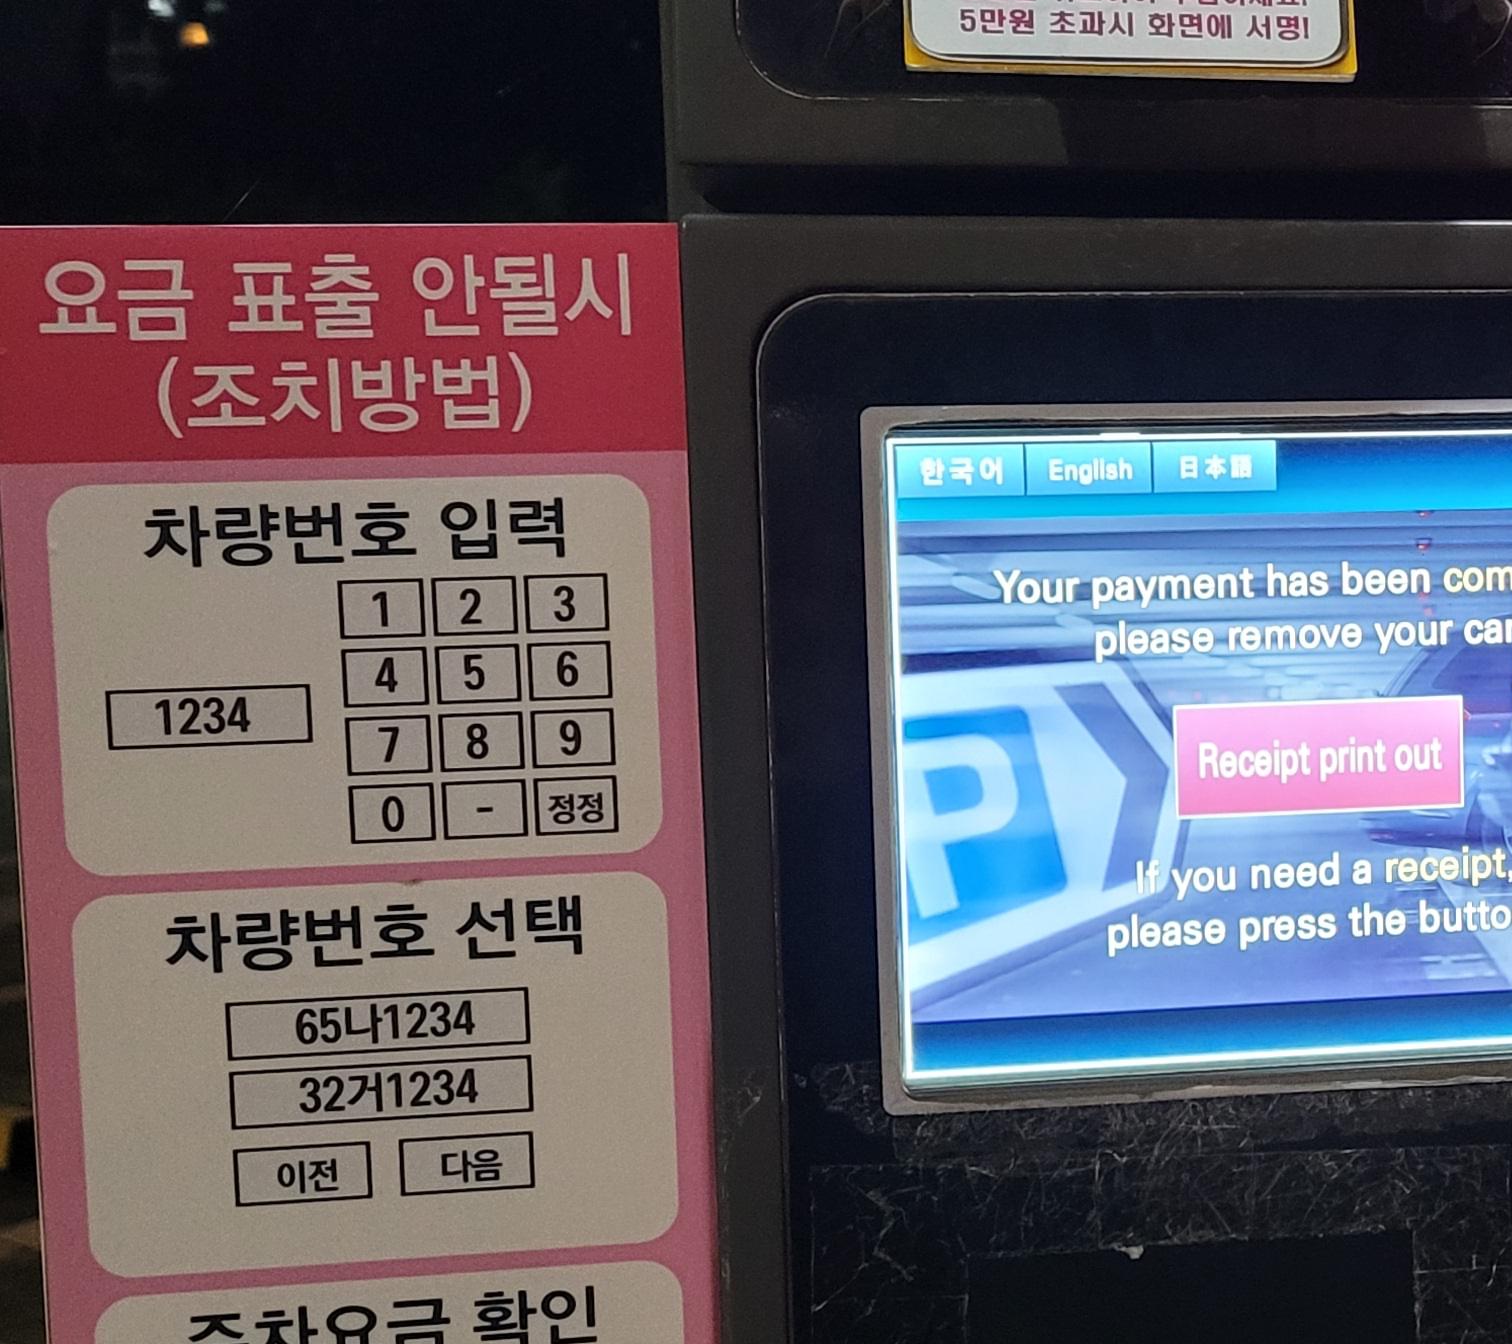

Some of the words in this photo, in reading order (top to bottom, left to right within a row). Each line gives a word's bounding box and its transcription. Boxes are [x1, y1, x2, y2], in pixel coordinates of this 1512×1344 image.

[959, 9, 1035, 35] 5만원
[1050, 10, 1134, 37] 초과시
[1148, 12, 1232, 38] 화면에
[1246, 15, 1309, 40] 서명!
[38, 258, 193, 341] 요금
[228, 254, 379, 339] 표출
[412, 252, 632, 337] 안될시
[157, 352, 531, 439] (조치방법)
[920, 456, 1005, 487] 한국어
[1048, 456, 1133, 485] English
[143, 499, 417, 567] 차량번호
[440, 498, 566, 559] 입력
[994, 570, 1076, 606] Your
[1091, 565, 1253, 609] payment
[1266, 563, 1328, 599] has
[1341, 560, 1430, 596] been
[1094, 620, 1213, 662] please
[1227, 622, 1361, 652] remove
[1374, 621, 1452, 654] your
[154, 698, 251, 736] 1234
[1198, 741, 1311, 782] Receipt
[1319, 739, 1387, 779] print
[1396, 738, 1442, 771] out
[547, 792, 605, 825] 정정
[1136, 859, 1161, 895] If
[1171, 864, 1237, 899] you
[1250, 857, 1340, 890] need
[1351, 861, 1373, 887] a
[166, 903, 435, 974] 차량번호
[455, 894, 584, 960] 선택
[1107, 915, 1226, 956] please
[1240, 913, 1337, 950] press
[1349, 905, 1405, 937] the
[295, 1000, 475, 1046] 65나1234
[298, 1068, 478, 1114] 32거1234
[277, 1158, 339, 1194] 이전
[440, 1147, 503, 1183] 다음
